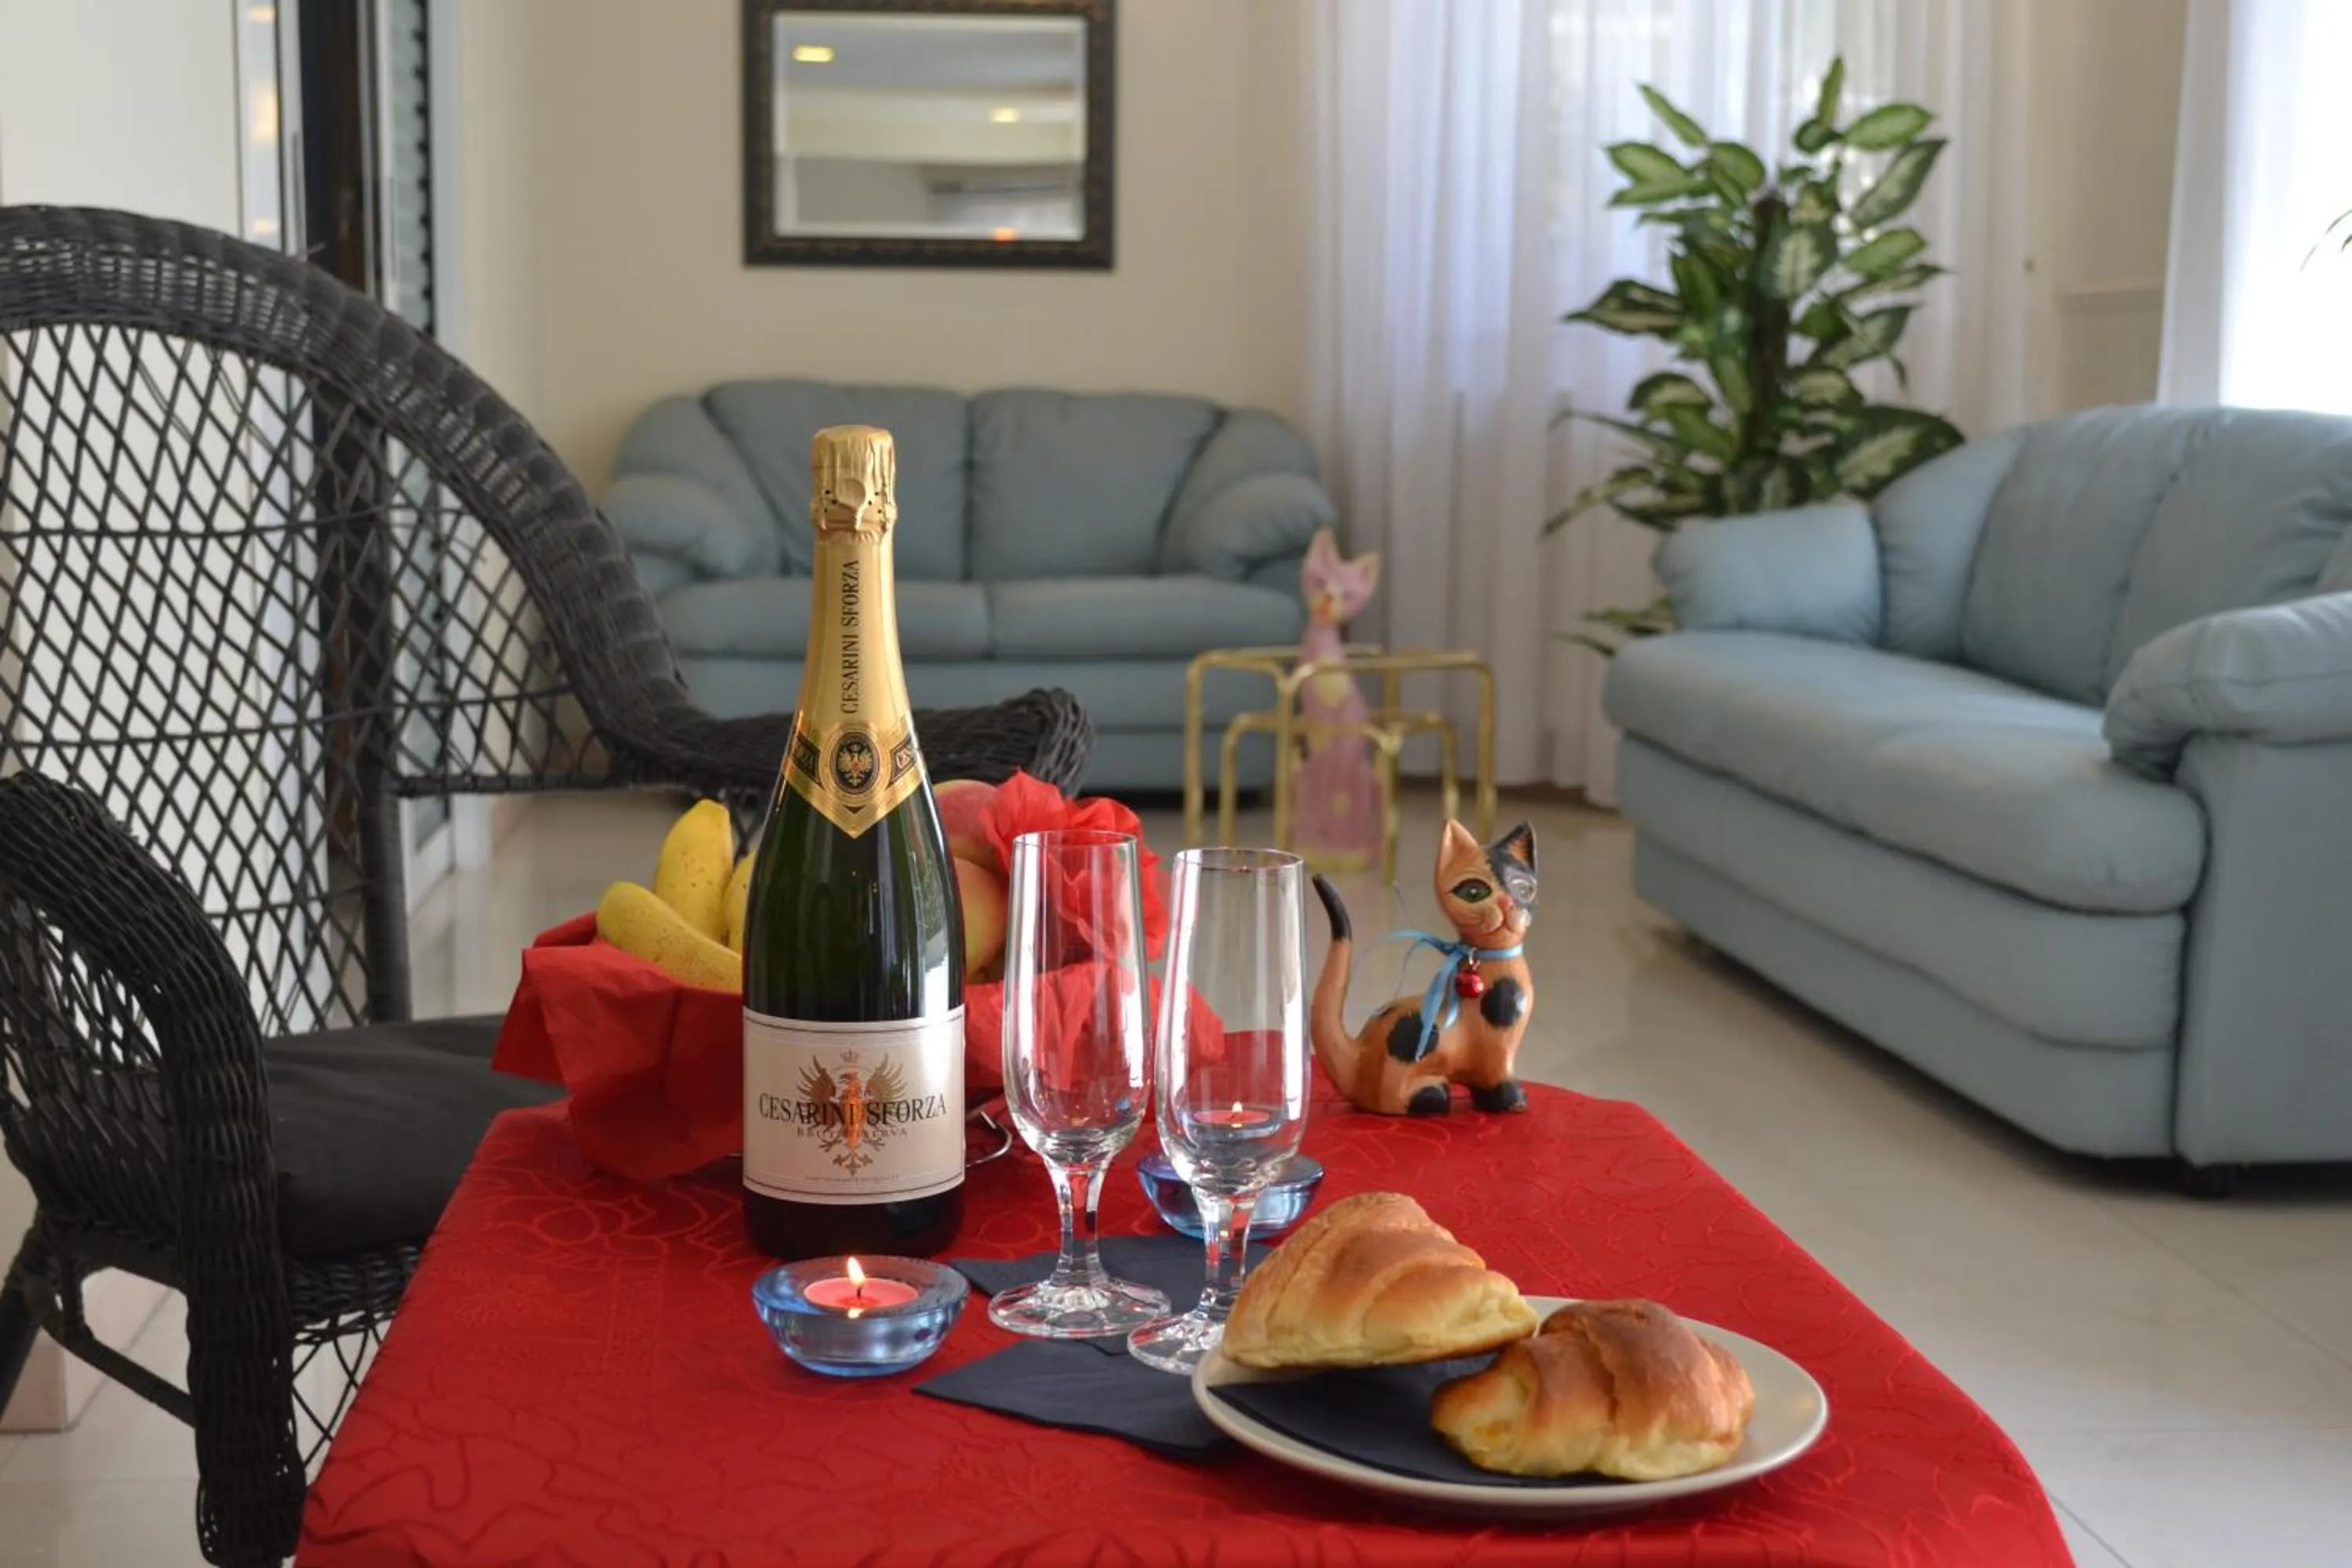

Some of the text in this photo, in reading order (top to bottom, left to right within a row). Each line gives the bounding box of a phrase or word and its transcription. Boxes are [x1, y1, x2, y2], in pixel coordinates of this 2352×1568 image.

[840, 560, 859, 714] CESARINI SFORZA
[758, 1092, 947, 1126] CESARINI SFORZA
